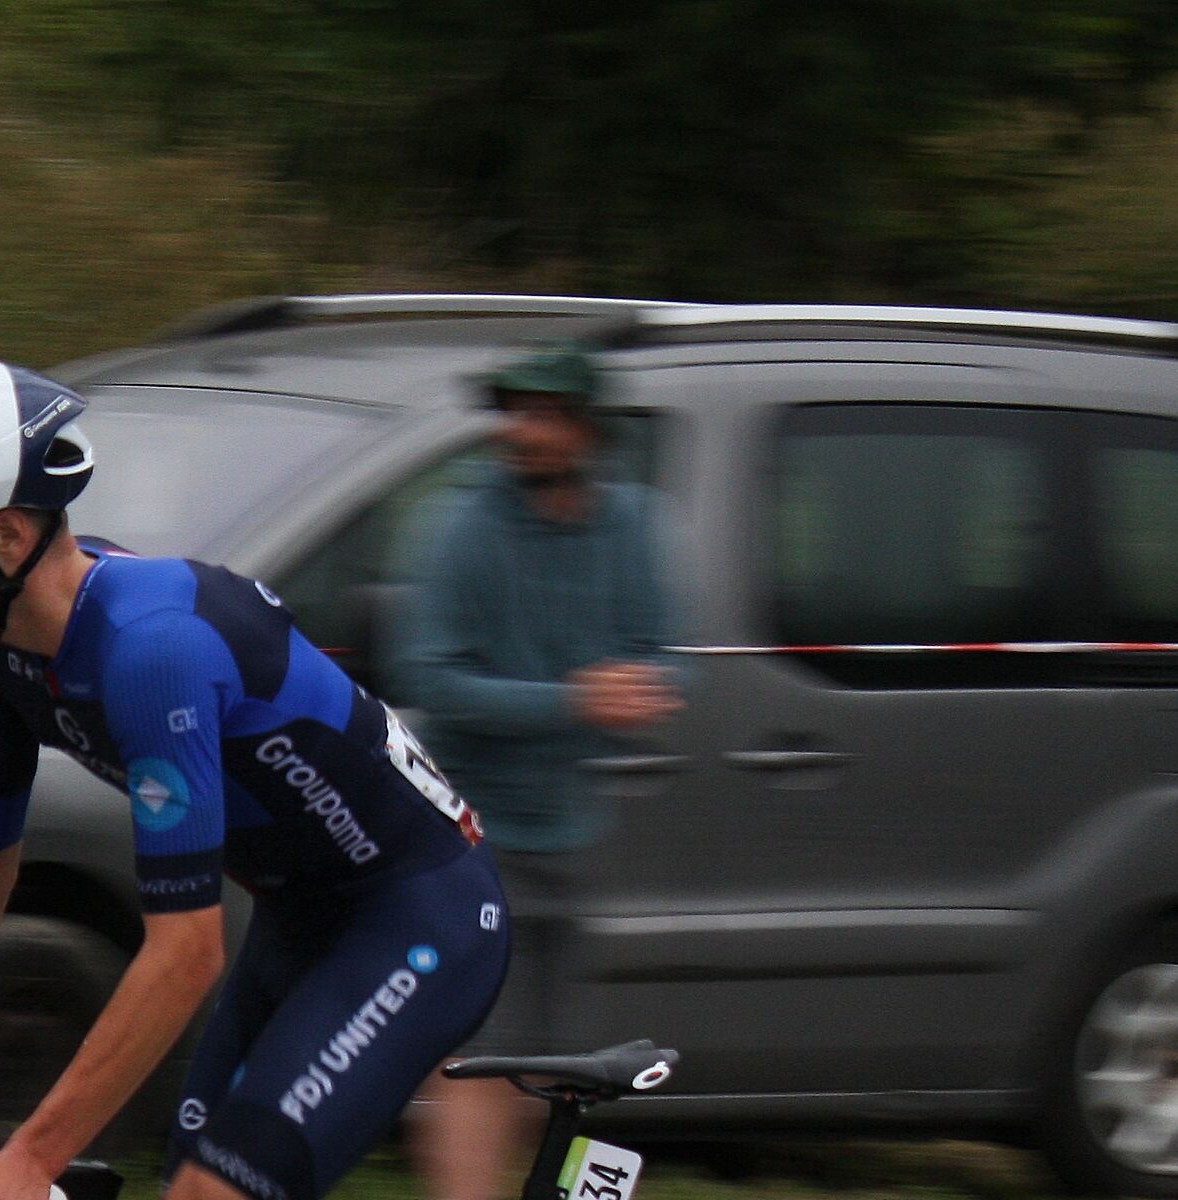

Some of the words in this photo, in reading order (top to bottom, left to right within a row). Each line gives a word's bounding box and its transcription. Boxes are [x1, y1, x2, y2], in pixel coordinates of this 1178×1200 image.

[256, 734, 379, 865] Groupama
[279, 1049, 335, 1125] FDJ
[328, 968, 419, 1071] UNITED
